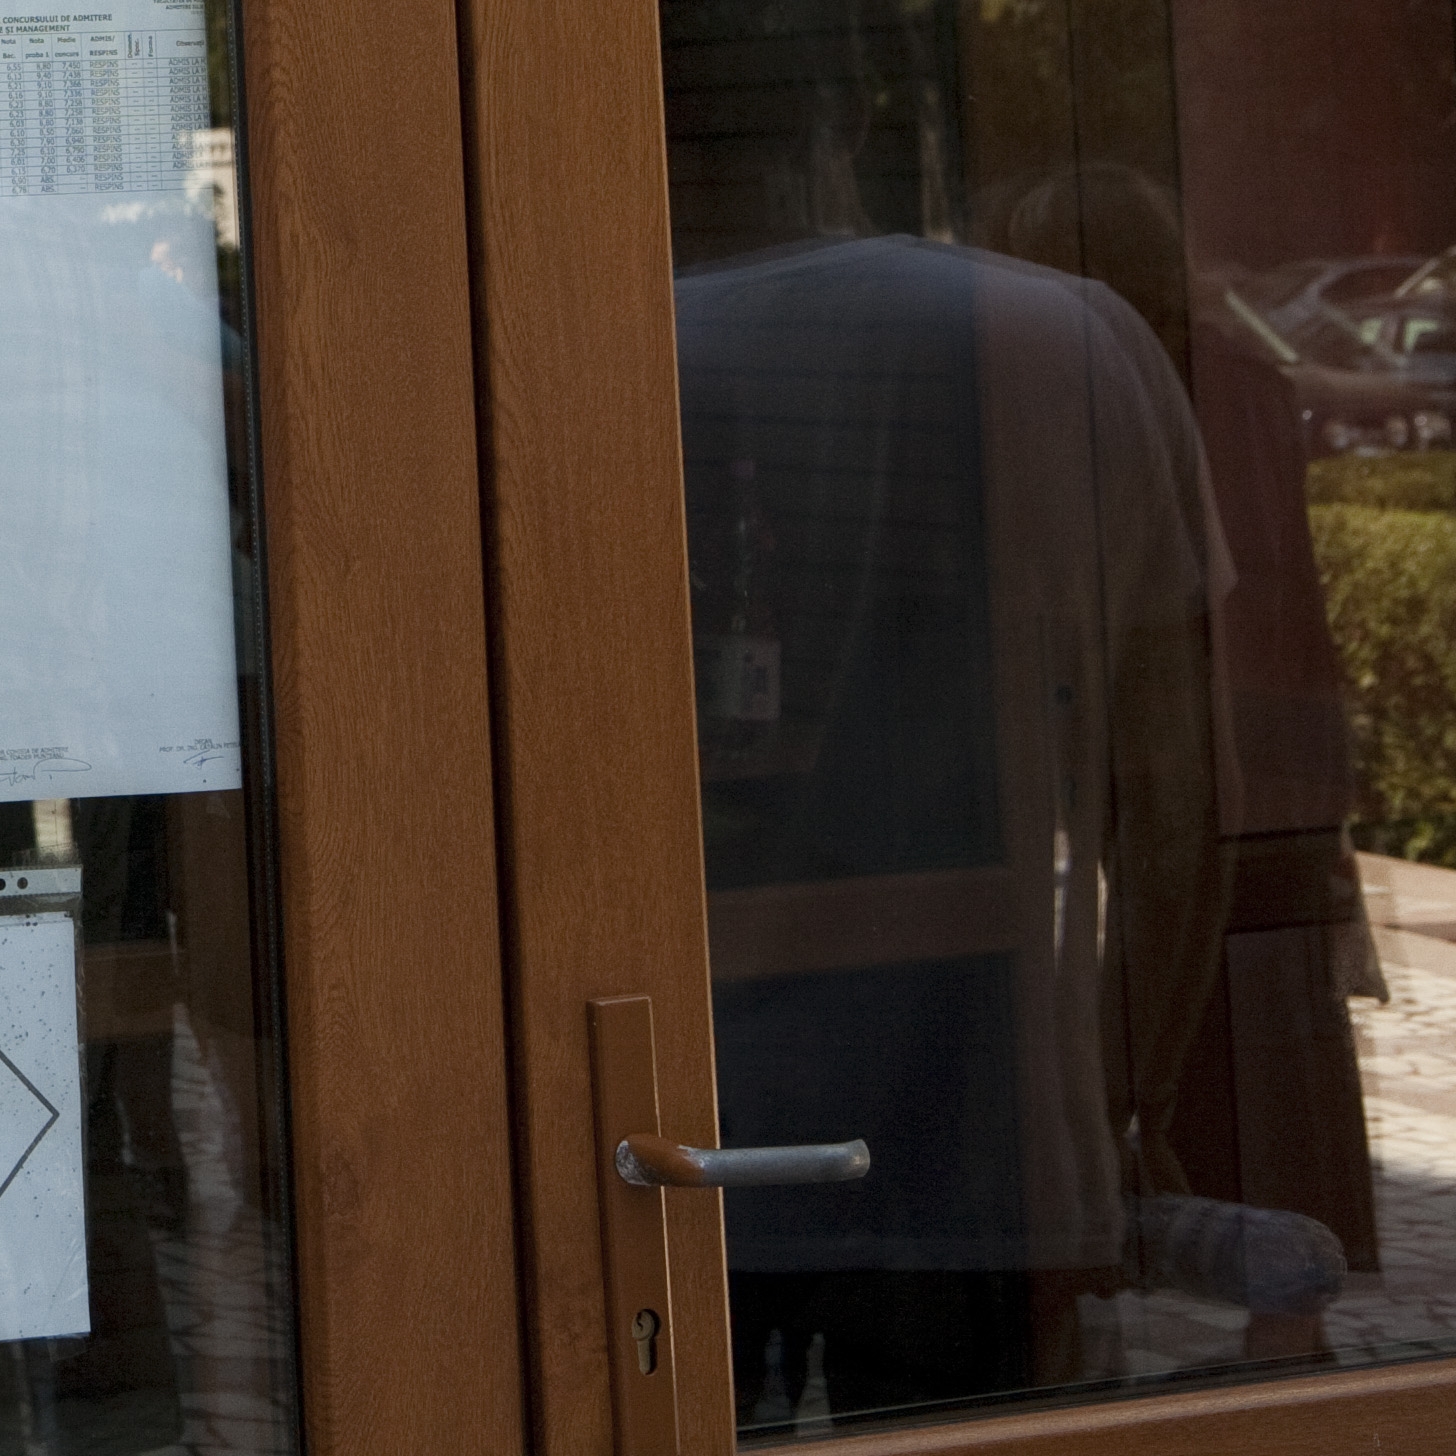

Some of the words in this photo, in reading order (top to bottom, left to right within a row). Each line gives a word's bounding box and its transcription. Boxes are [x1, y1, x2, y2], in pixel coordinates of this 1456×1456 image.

[2, 15, 58, 25] CONCURSULUI
[60, 15, 71, 23] DE
[72, 14, 112, 23] ADMITERE
[15, 25, 70, 34] MANAGEMENT
